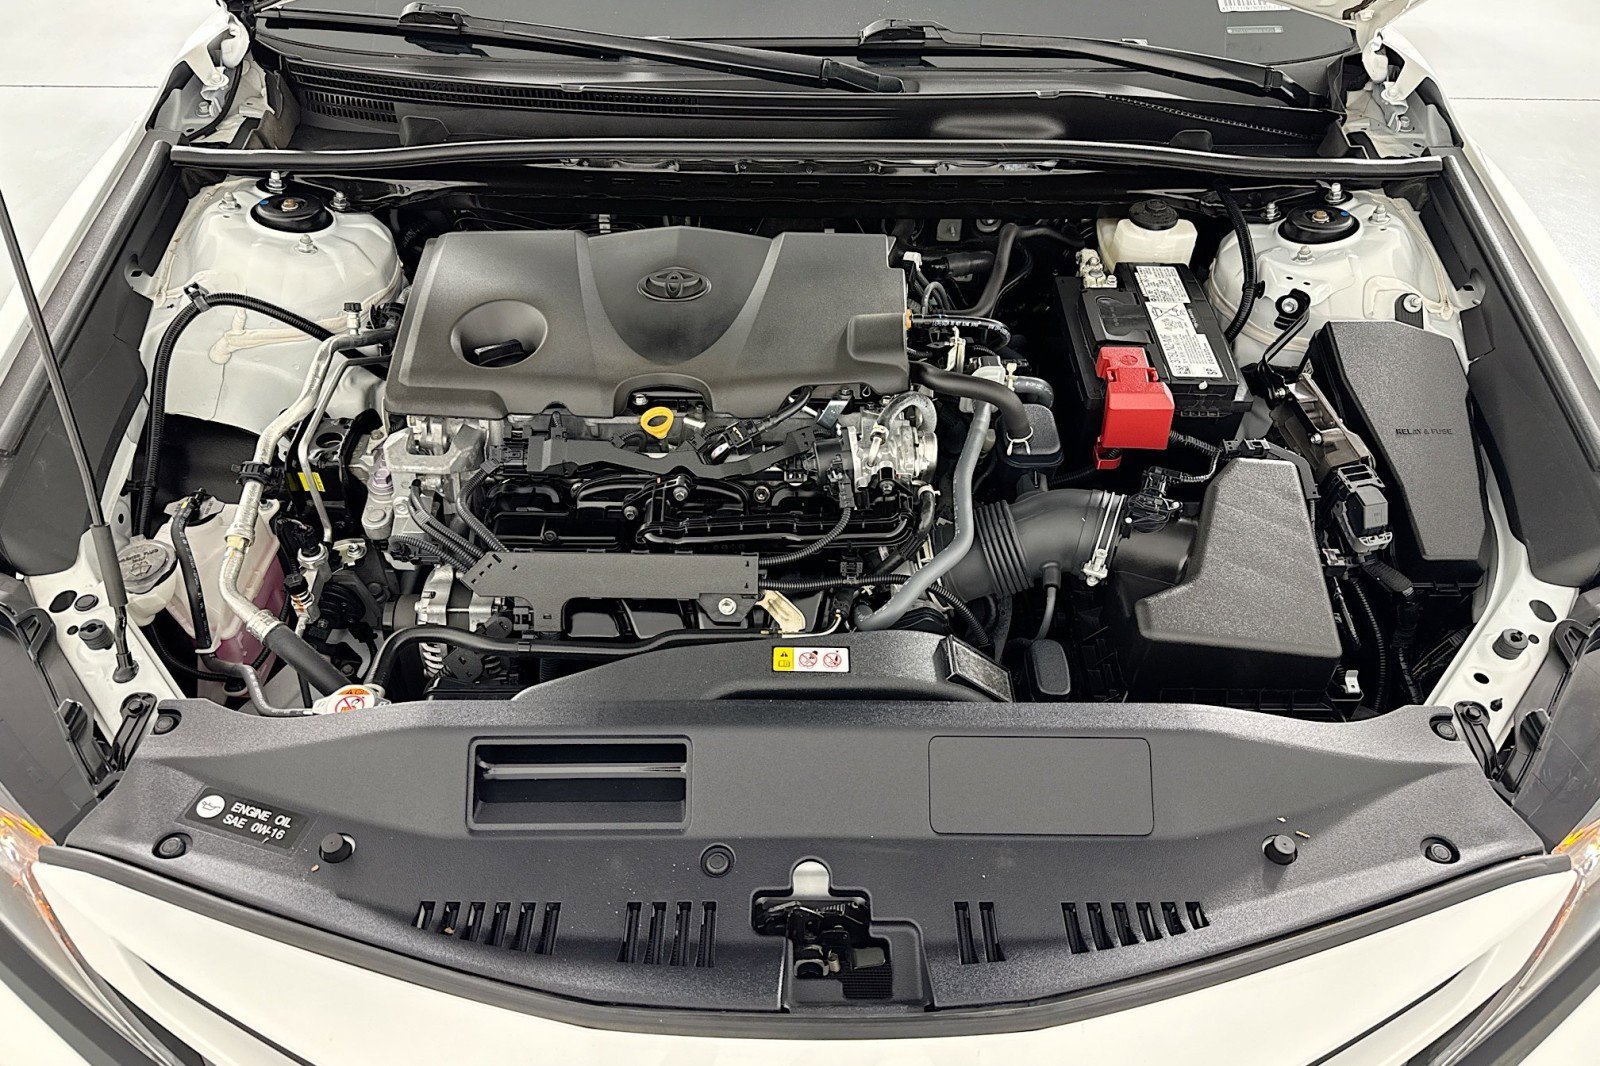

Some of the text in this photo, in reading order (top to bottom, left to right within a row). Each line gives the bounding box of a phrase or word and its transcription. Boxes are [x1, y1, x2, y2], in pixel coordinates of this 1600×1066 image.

[222, 813, 286, 840] SAE 0W-16
[230, 801, 292, 829] ENGINE OIL
